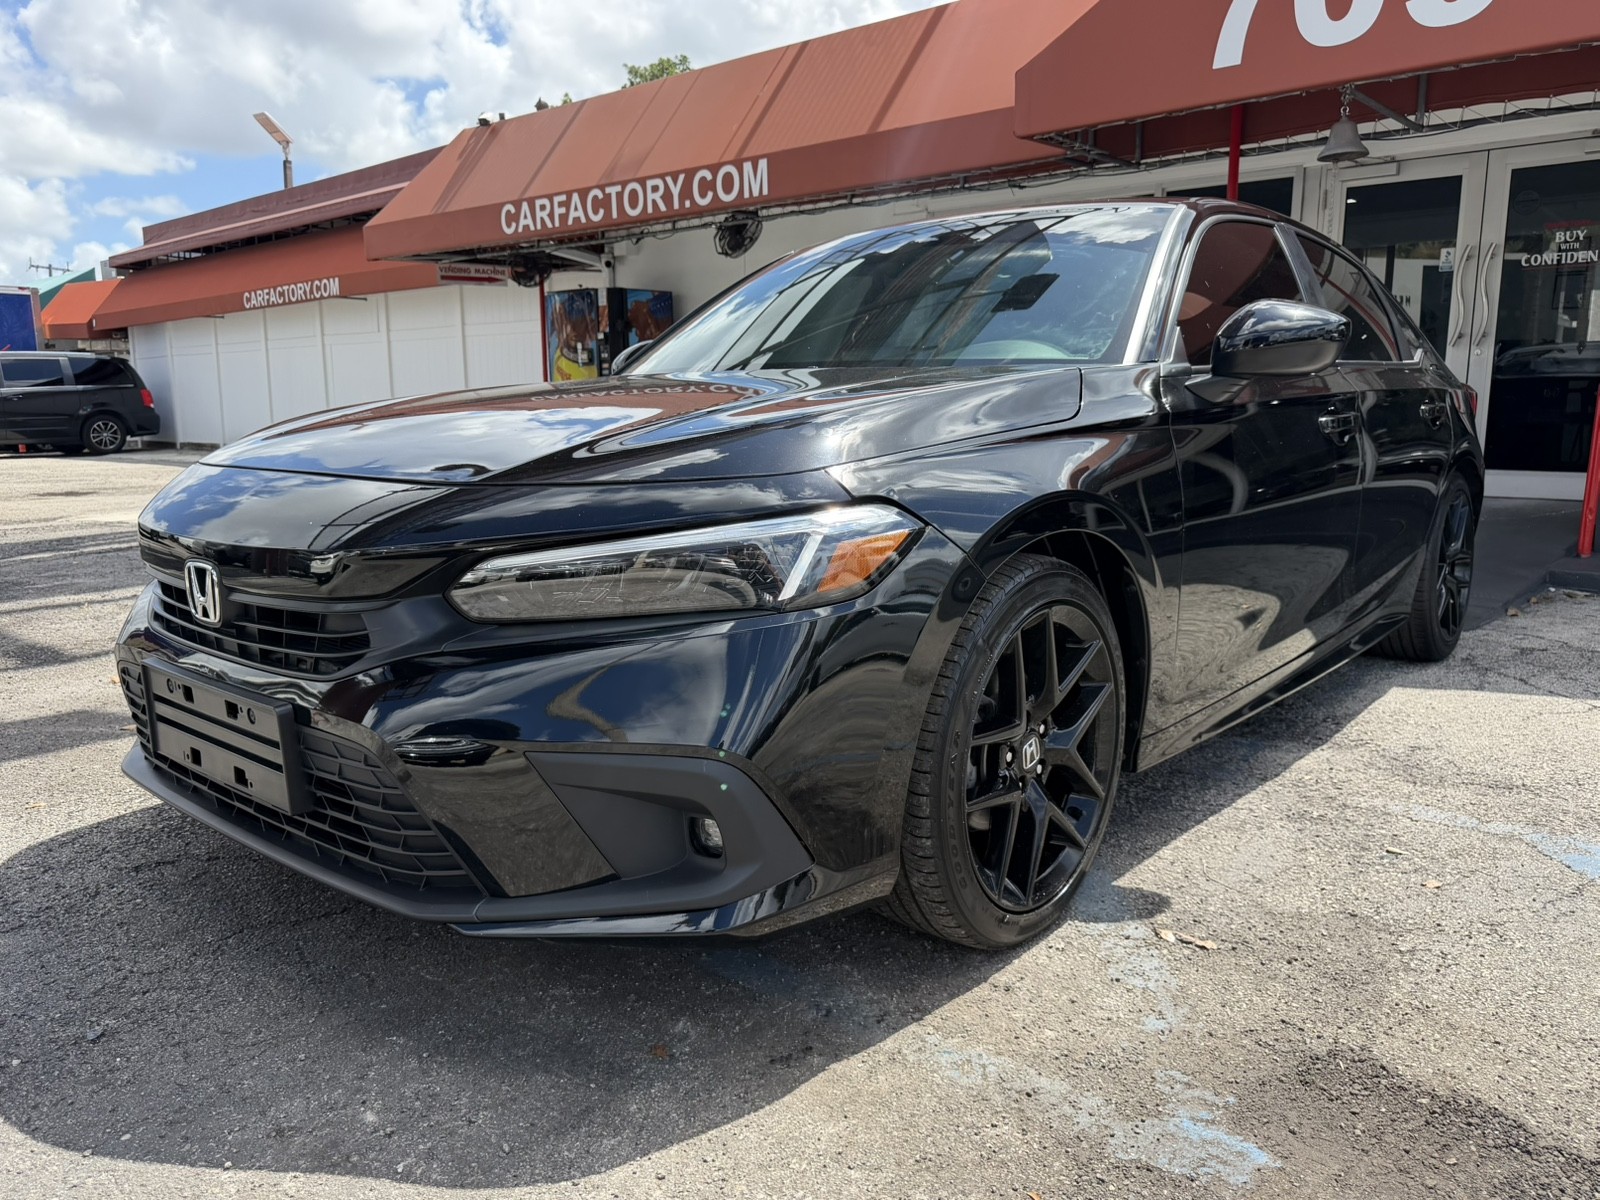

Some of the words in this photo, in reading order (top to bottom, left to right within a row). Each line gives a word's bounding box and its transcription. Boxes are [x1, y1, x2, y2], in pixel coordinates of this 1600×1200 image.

[500, 157, 769, 235] CARFACTORY.COM
[1555, 229, 1587, 243] BUY
[1560, 242, 1580, 250] WITH
[1521, 249, 1599, 267] CONFIDEN
[439, 265, 471, 275] VENDING
[475, 266, 506, 276] MACHINE
[243, 277, 340, 309] CARFACTORY.COM
